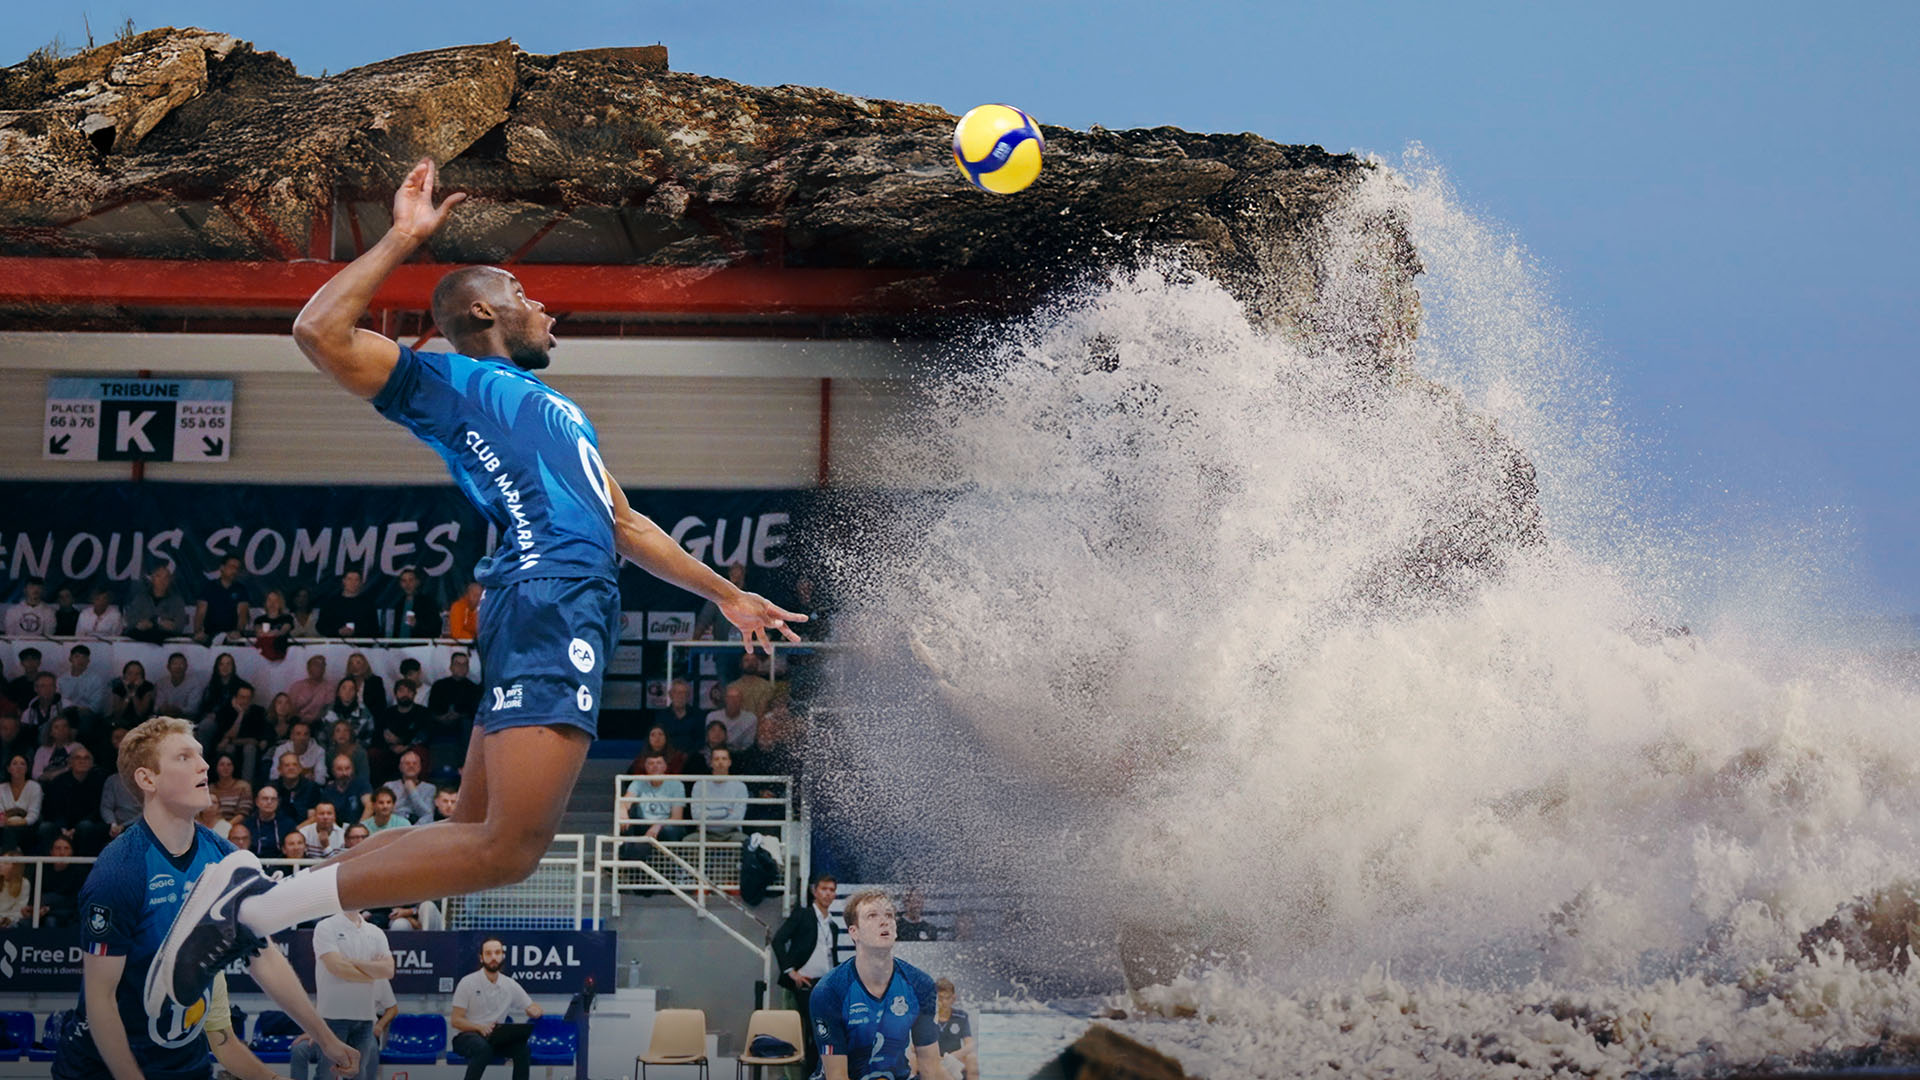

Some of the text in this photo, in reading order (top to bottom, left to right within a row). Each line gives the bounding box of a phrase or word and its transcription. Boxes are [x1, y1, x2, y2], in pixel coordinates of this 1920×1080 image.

[101, 383, 180, 397] TRIBUNE
[51, 404, 95, 414] PLACES
[182, 405, 226, 415] PLACES
[50, 416, 95, 428] 66 à 76
[181, 417, 225, 429] 55 à 65
[116, 410, 157, 453] K
[466, 431, 536, 551] CLUB MRMARA
[204, 521, 460, 583] SOMMES
[577, 684, 593, 712] 6
[22, 946, 84, 963] Free D
[394, 950, 434, 968] TAL
[503, 944, 581, 967] IDAL
[511, 971, 563, 981] AVOCATS
